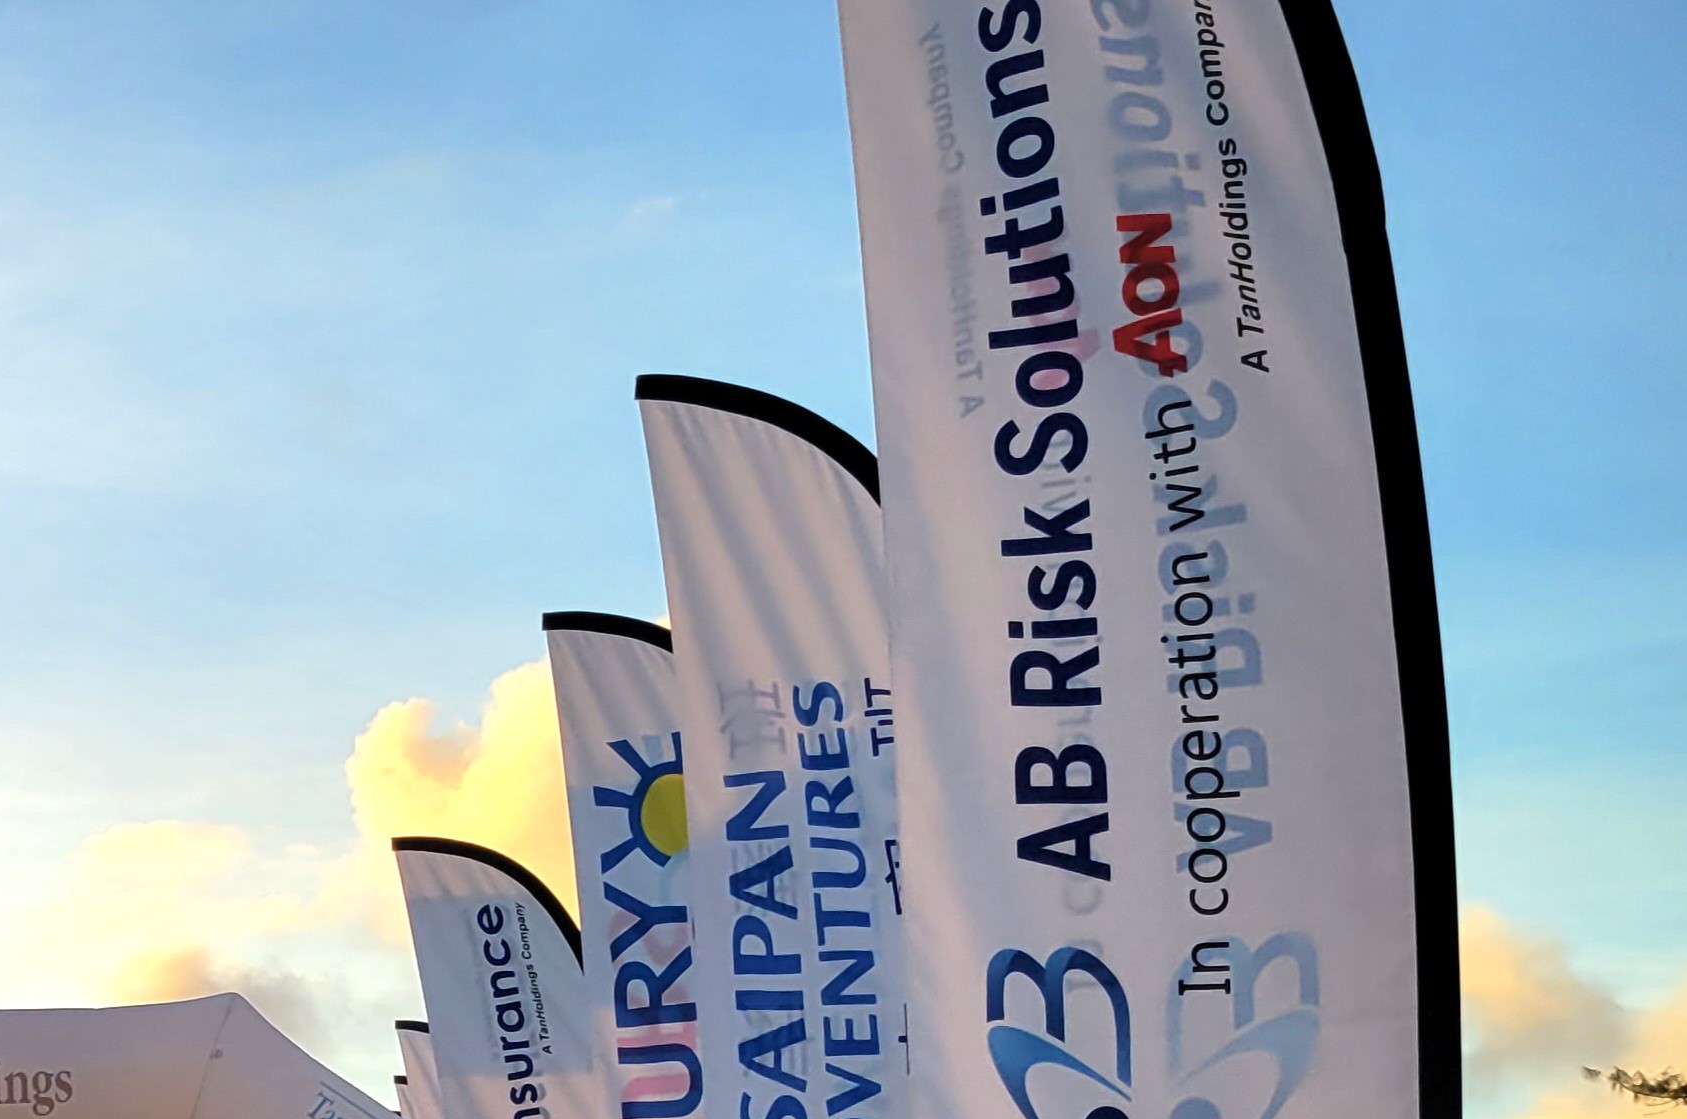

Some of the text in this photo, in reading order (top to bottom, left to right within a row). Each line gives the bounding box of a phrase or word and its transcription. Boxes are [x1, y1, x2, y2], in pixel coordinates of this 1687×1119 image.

[1218, 137, 1265, 338] TanHoldings
[1240, 349, 1270, 373] A
[977, 0, 1112, 882] AB Risk Solutions
[1145, 400, 1206, 532] with
[1160, 551, 1241, 916] cooperation
[517, 903, 553, 1055] A TanHoldings Company
[1177, 941, 1231, 996] In
